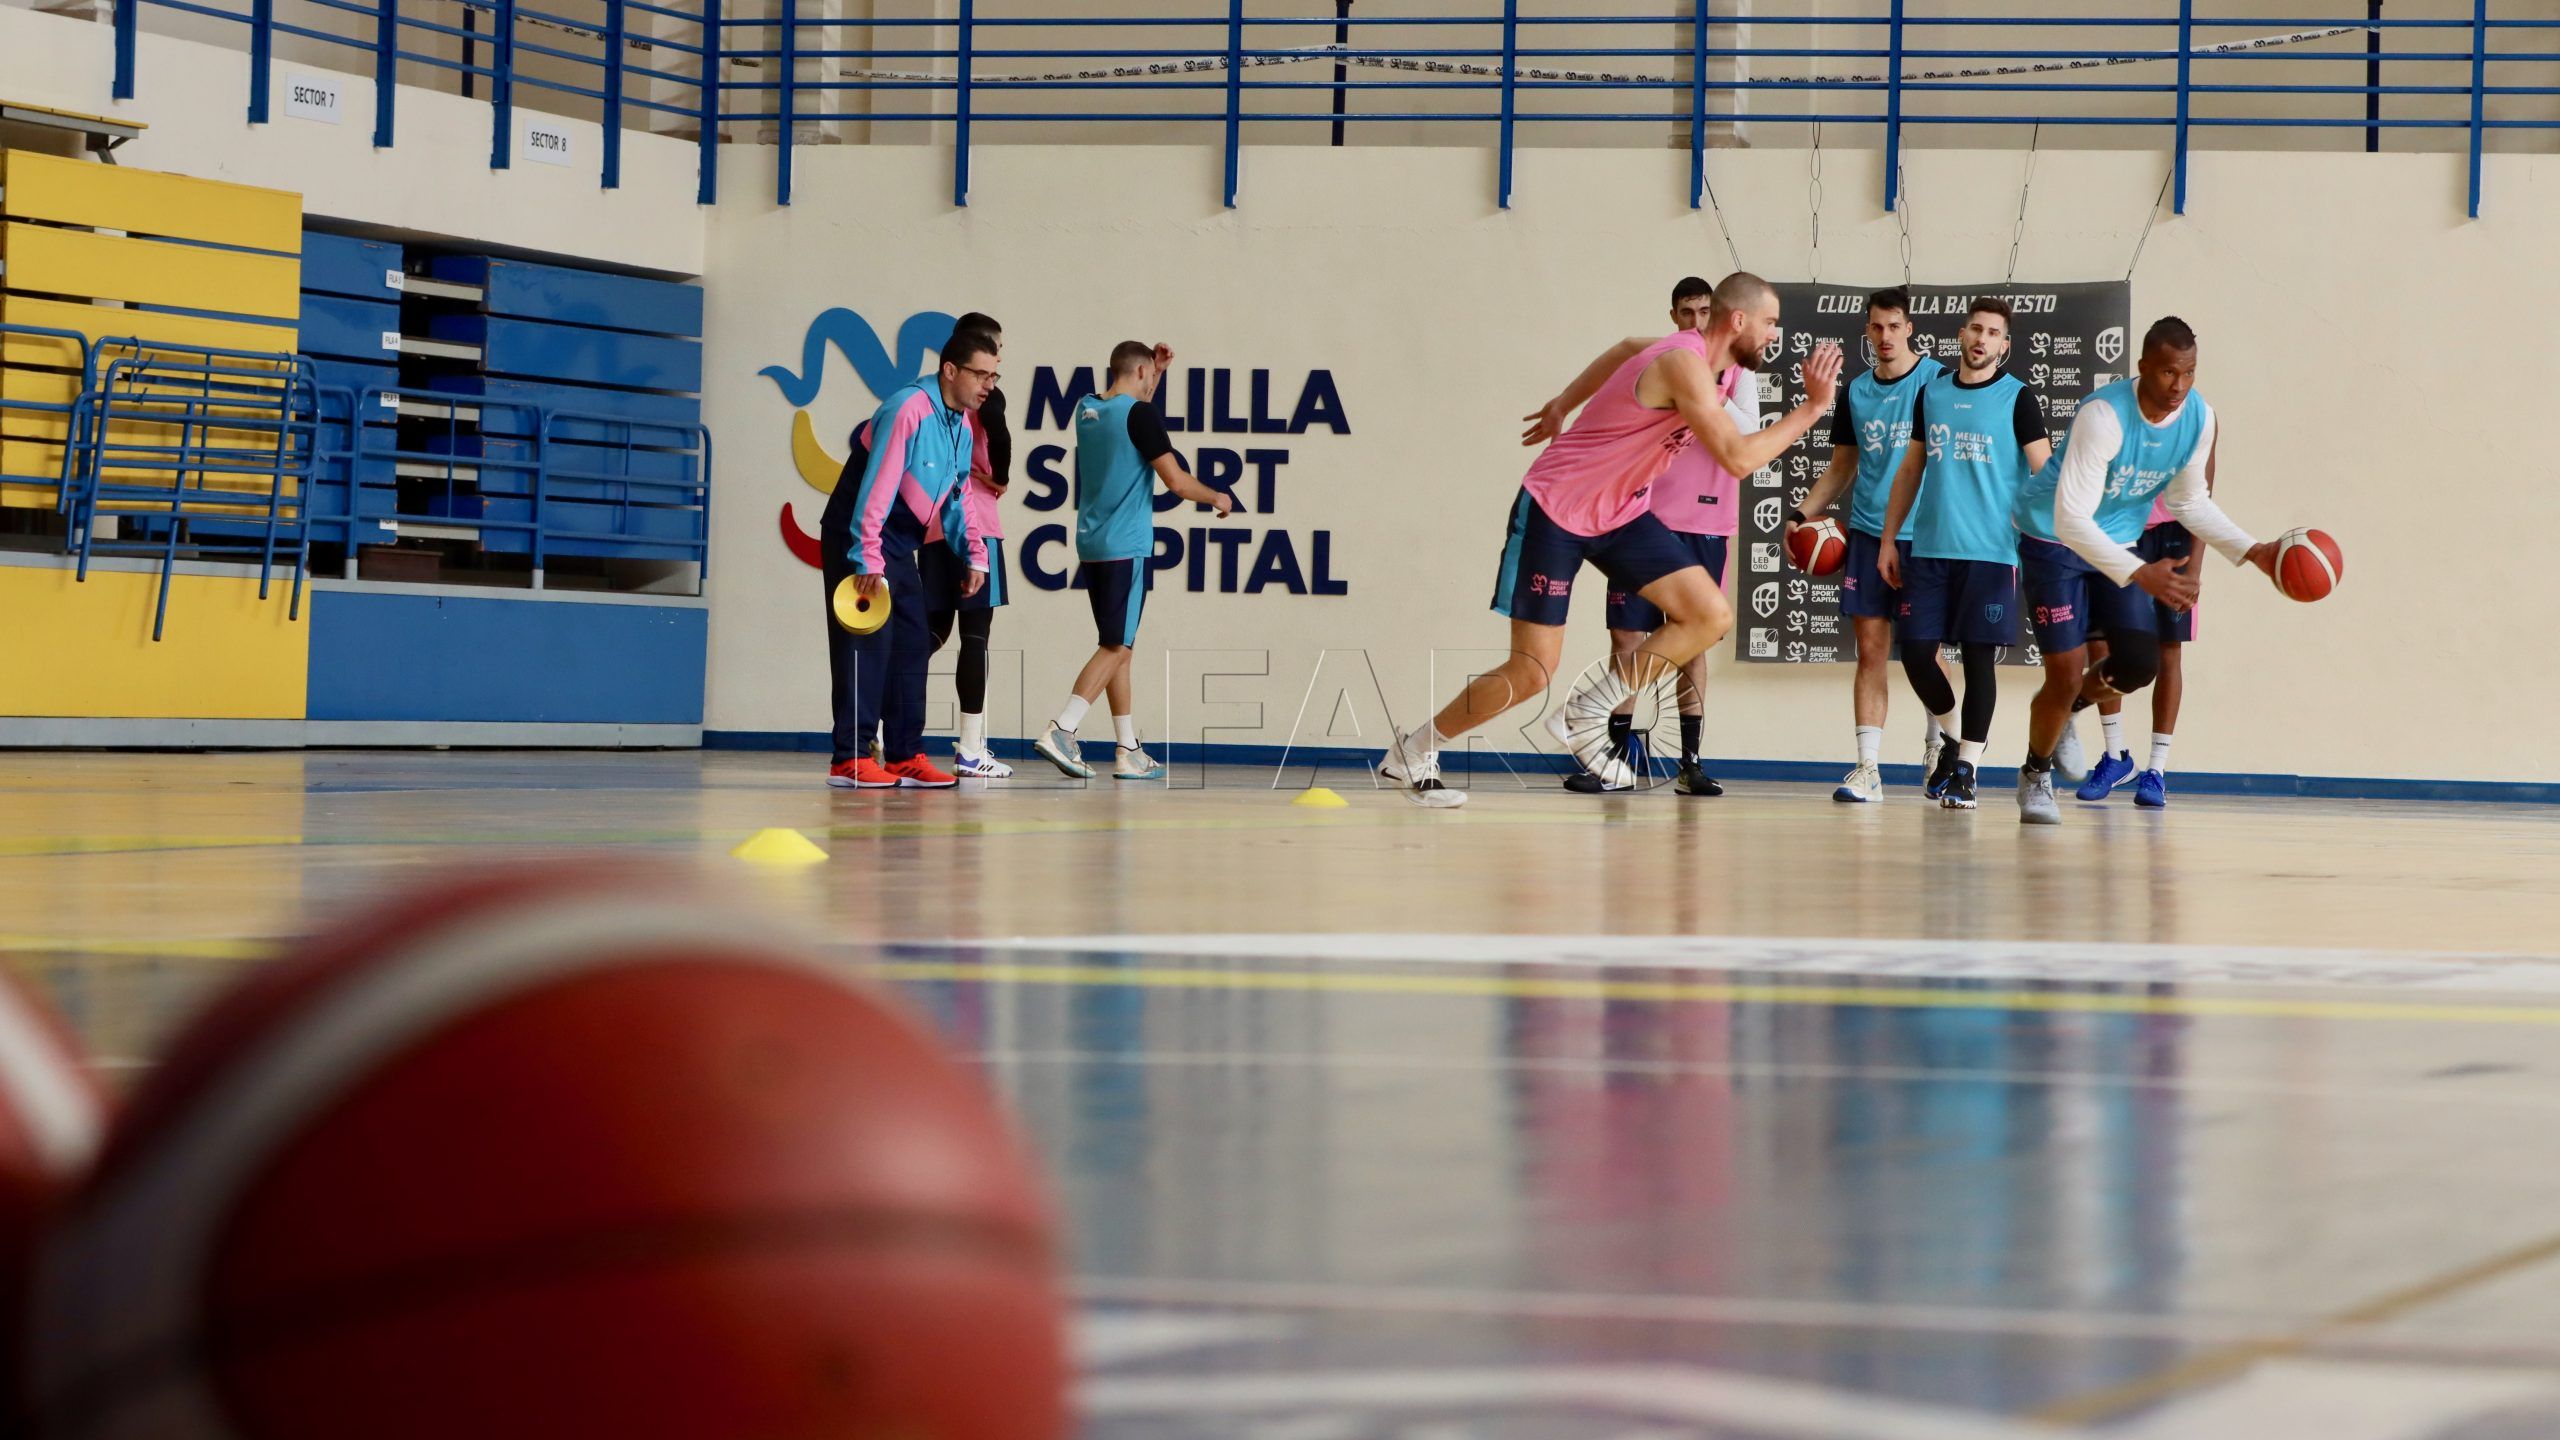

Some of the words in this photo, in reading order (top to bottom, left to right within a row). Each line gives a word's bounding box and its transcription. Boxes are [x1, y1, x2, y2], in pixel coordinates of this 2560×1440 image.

[294, 86, 327, 107] SECTOR
[329, 93, 336, 109] 7
[531, 131, 560, 151] SECTOR
[561, 137, 567, 152] 8
[1816, 294, 1864, 314] CLUB
[1024, 366, 1352, 434] MLILLA
[1890, 421, 1913, 430] MELIL
[1890, 430, 1912, 440] SPO
[1954, 442, 1986, 452] SPORT
[1955, 432, 1993, 444] MELILLA
[1954, 451, 1992, 464] CAPITAL
[1023, 444, 1290, 514] SRT
[1020, 524, 1348, 596] CPITAL
